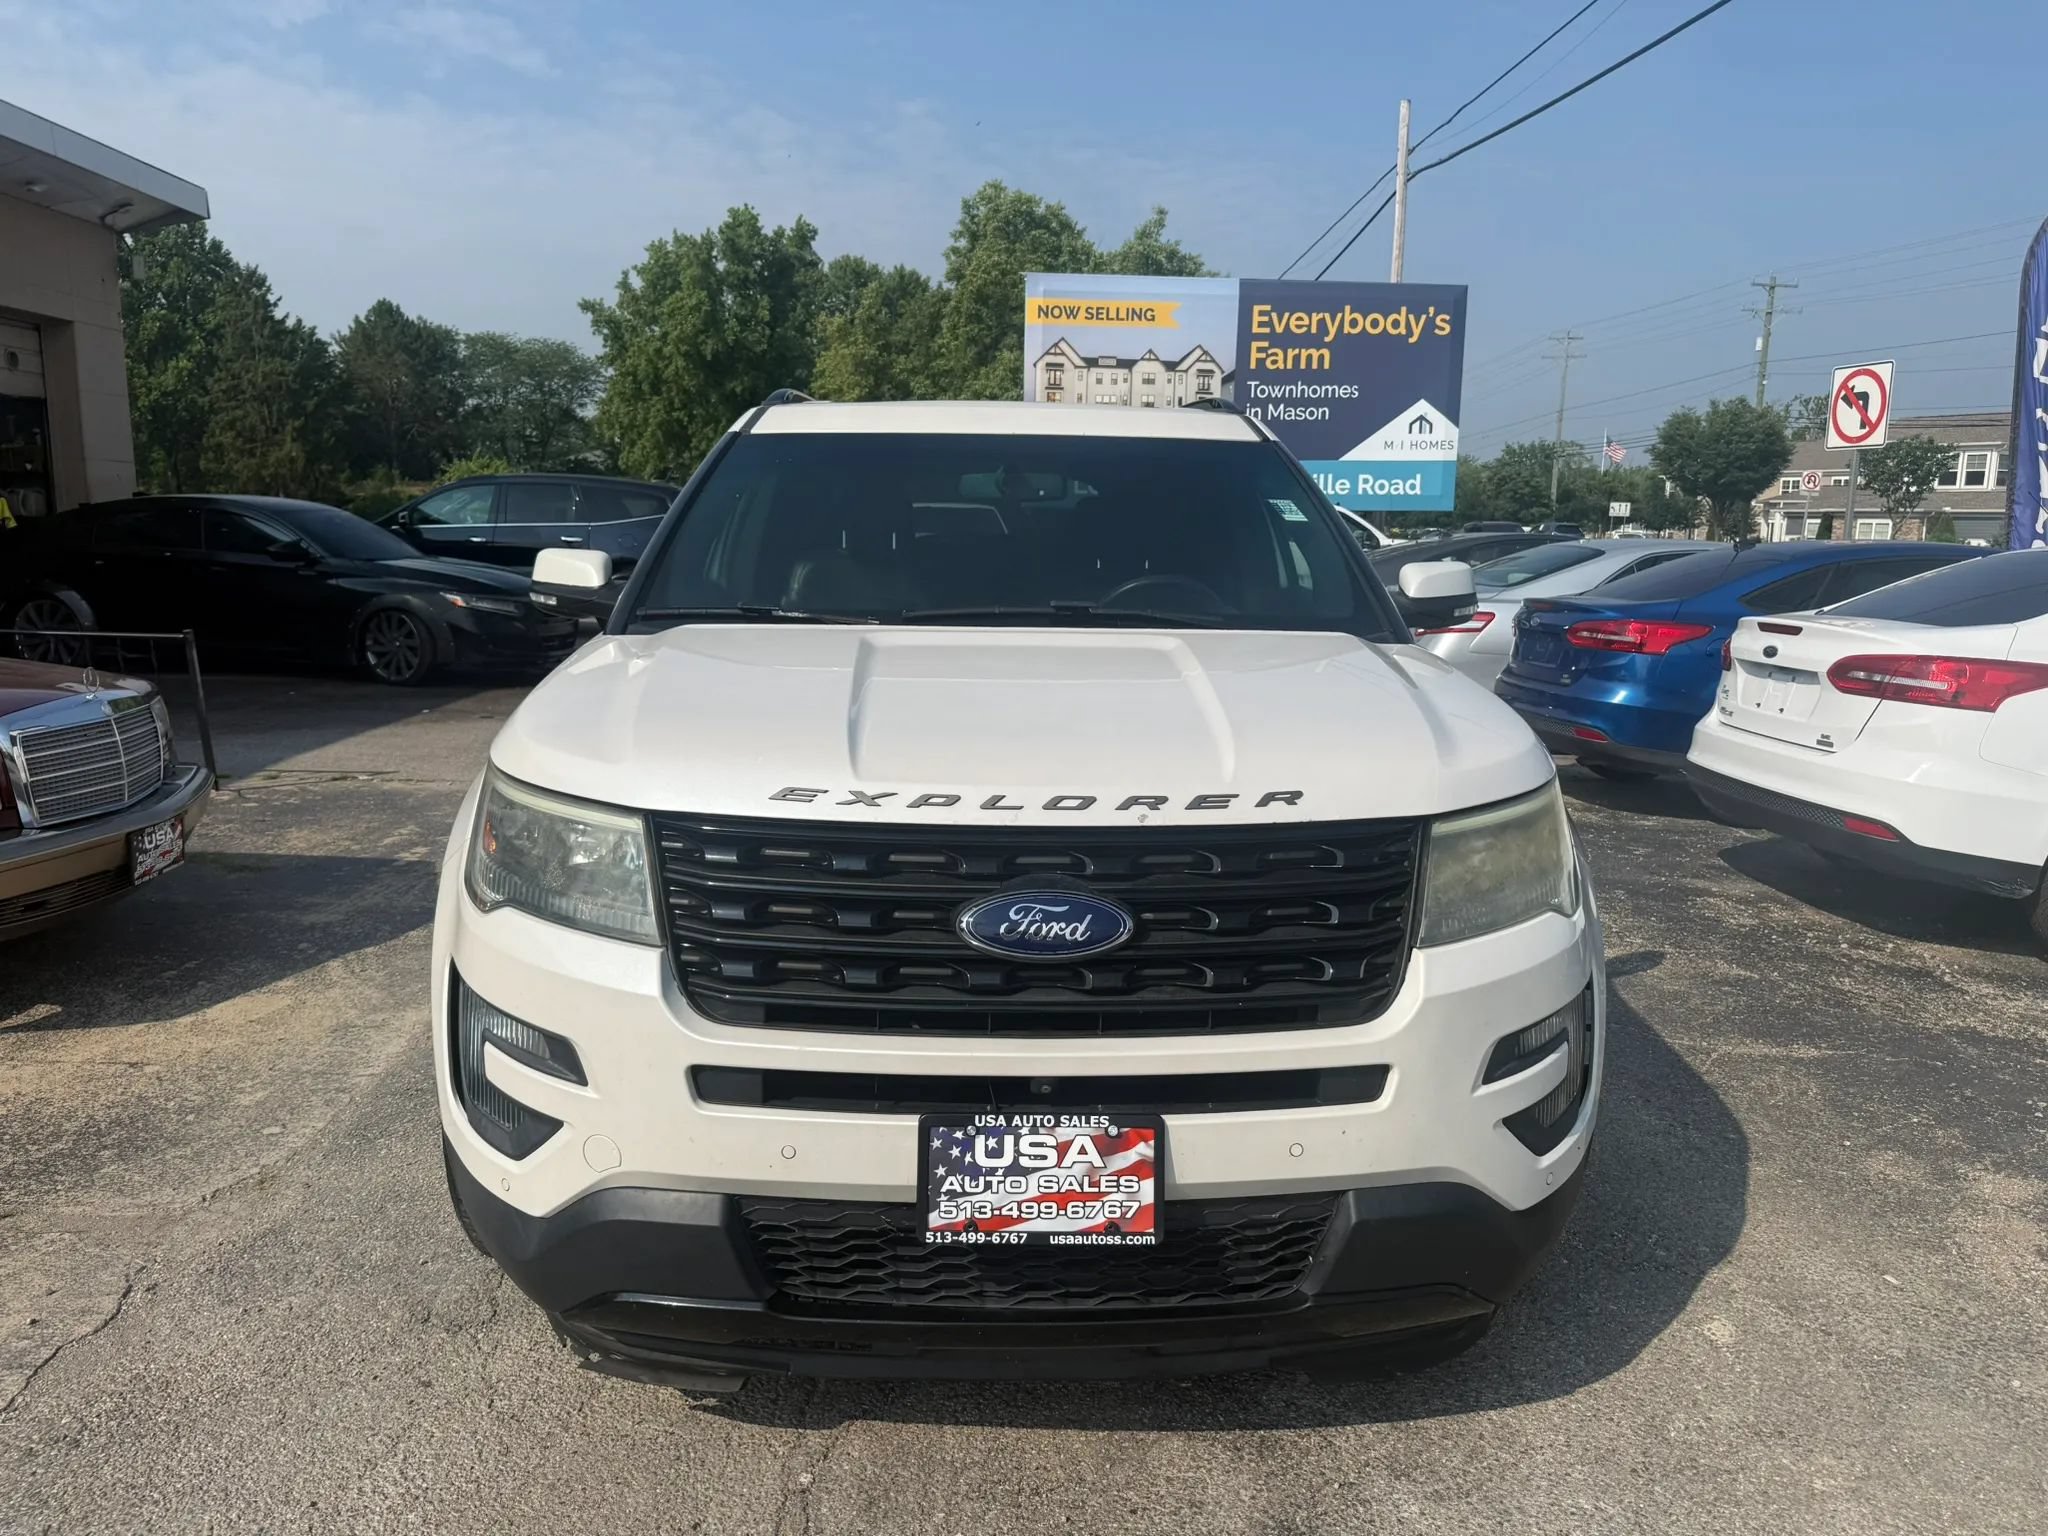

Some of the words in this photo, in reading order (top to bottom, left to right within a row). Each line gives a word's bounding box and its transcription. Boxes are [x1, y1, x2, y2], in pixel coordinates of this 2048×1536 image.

[1037, 304, 1081, 320] NOW
[1084, 306, 1156, 322] SELLING
[1251, 304, 1452, 344] Everybody’s
[1249, 341, 1331, 370] Farm
[1246, 380, 1359, 398] Townhomes
[1246, 403, 1262, 421] in
[1267, 403, 1329, 421] Mason
[1409, 440, 1454, 450] HOMES
[1357, 473, 1421, 495] Road
[767, 786, 1305, 812] EXPLORER
[144, 827, 174, 849] USA
[1000, 903, 1093, 941] Ford
[974, 1115, 1007, 1127] USA
[1012, 1115, 1055, 1127] AUTO
[1060, 1115, 1110, 1127] SALES
[973, 1134, 1107, 1168] USA
[940, 1175, 1028, 1194] AUTO
[1038, 1175, 1141, 1194] SALES
[938, 1200, 1142, 1220] 513-499-6767
[925, 1231, 1027, 1244] 513-499-6767
[1050, 1232, 1156, 1245] usaautoss.com
